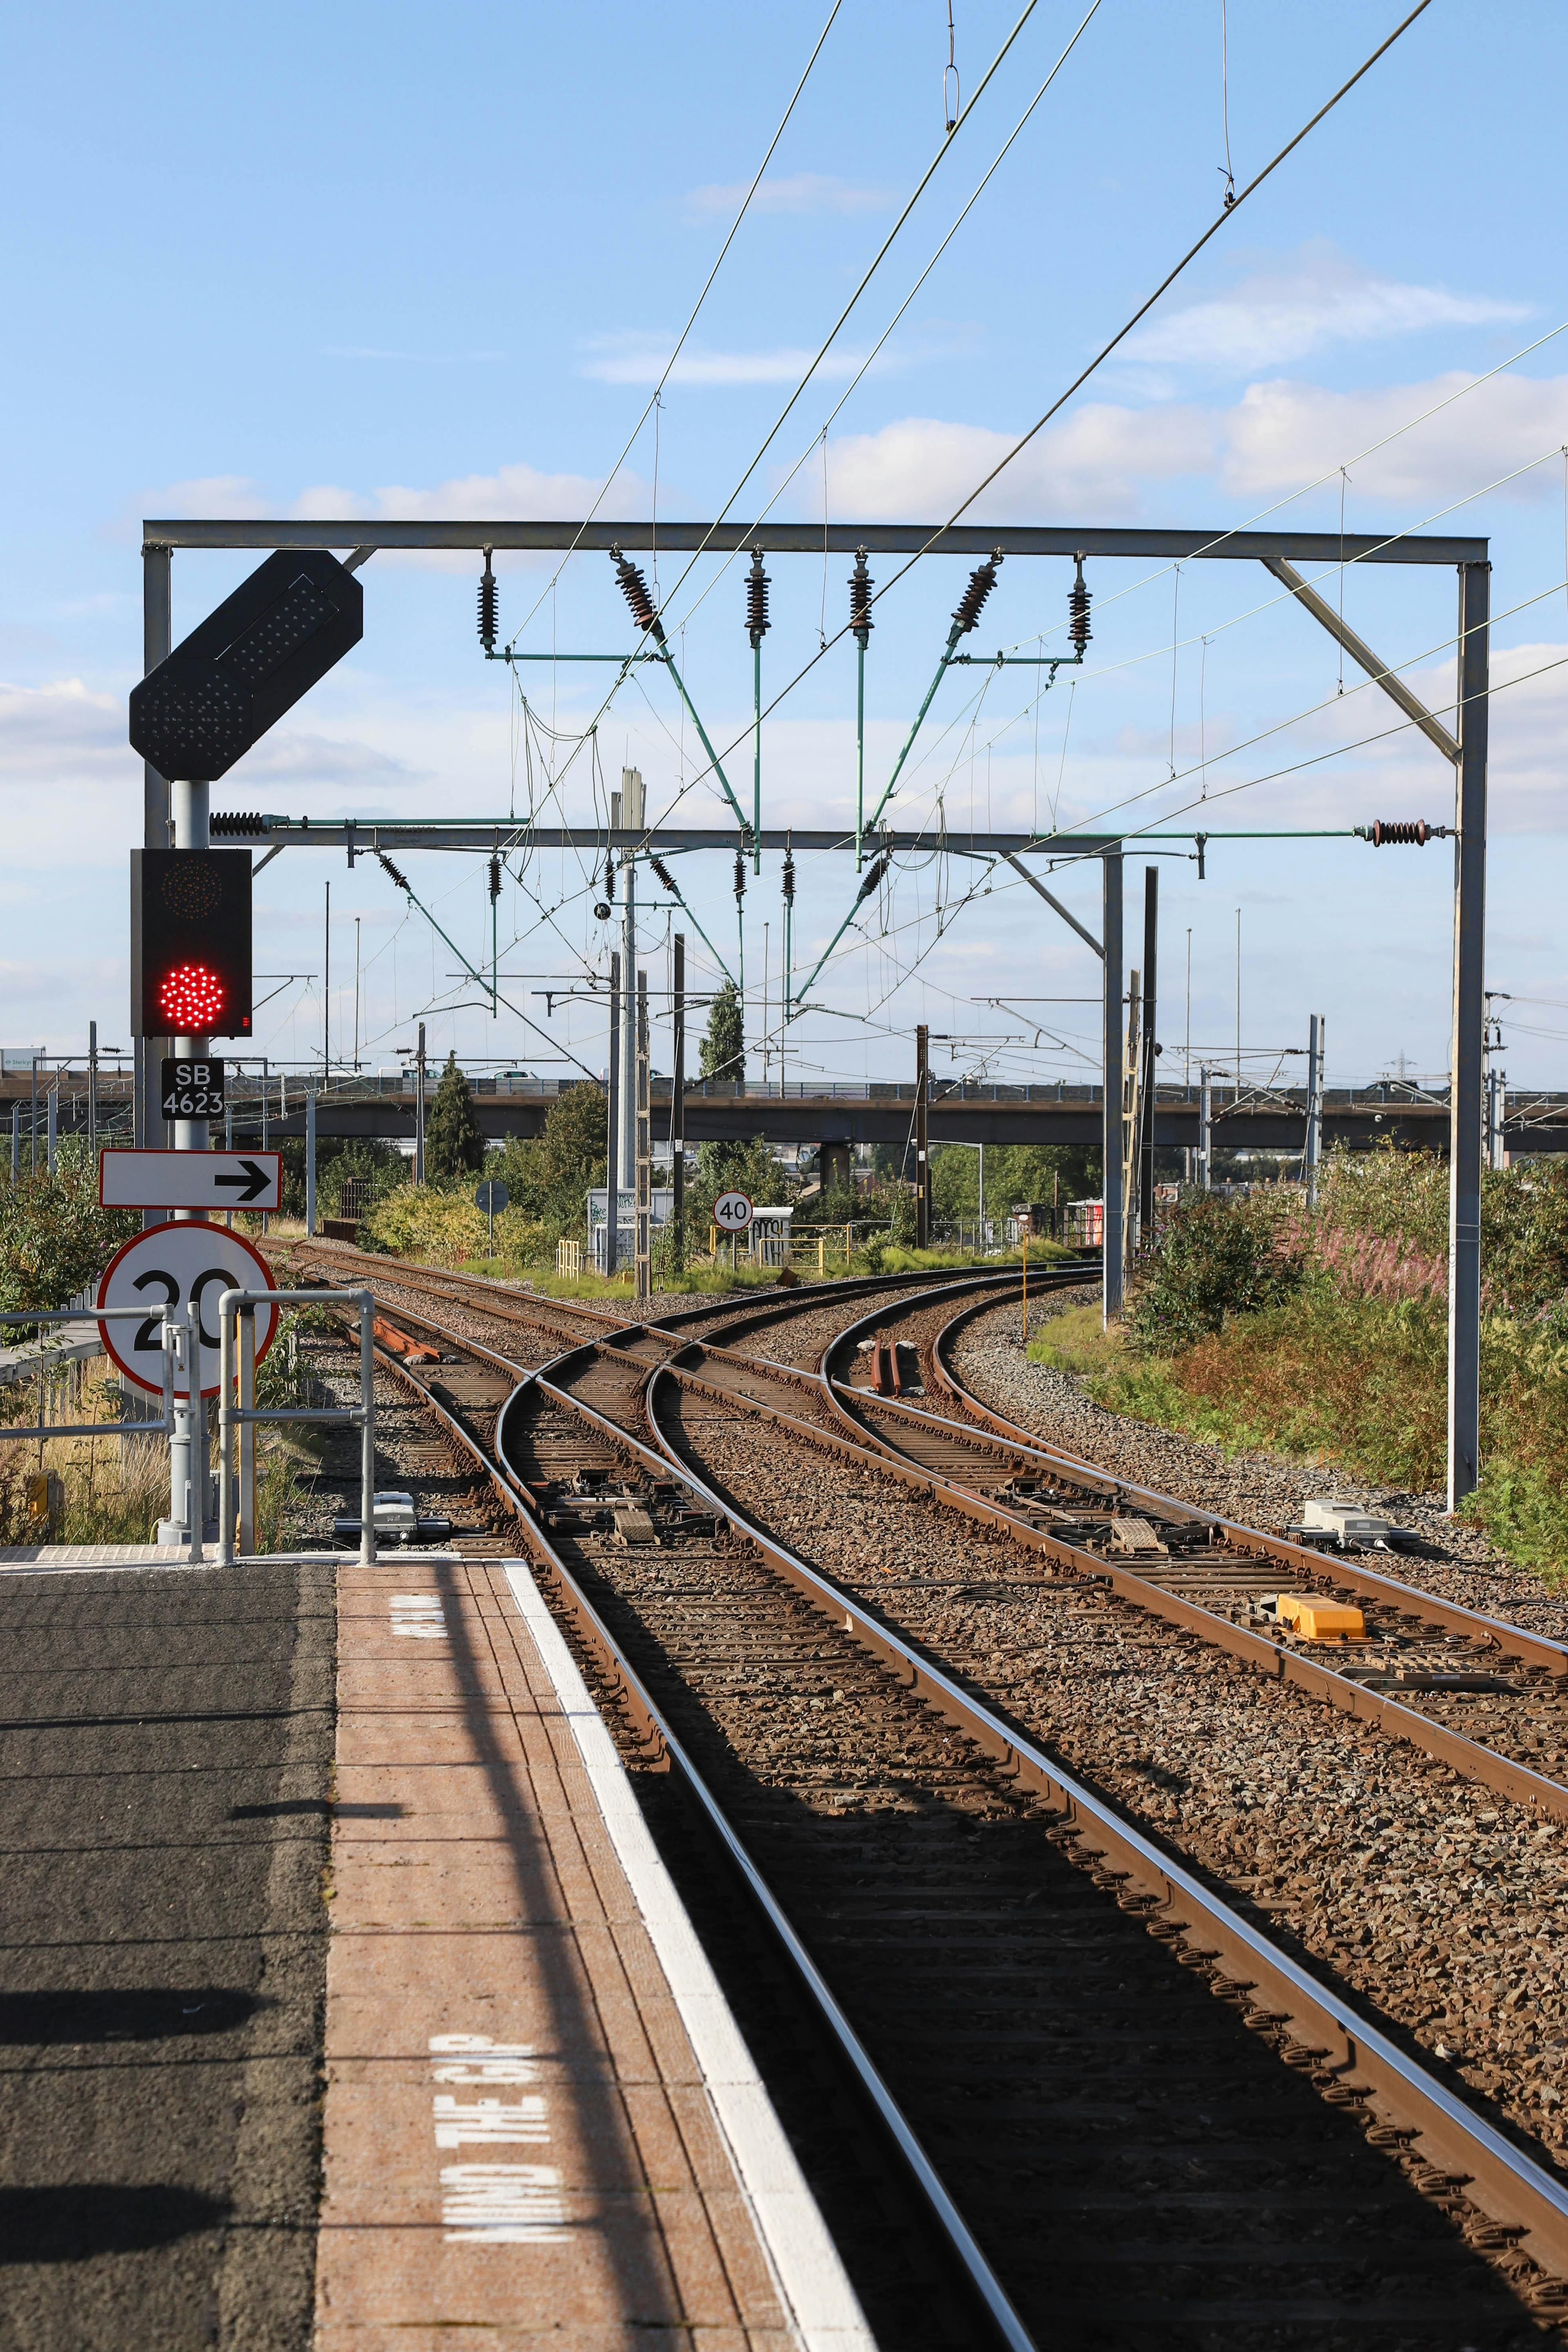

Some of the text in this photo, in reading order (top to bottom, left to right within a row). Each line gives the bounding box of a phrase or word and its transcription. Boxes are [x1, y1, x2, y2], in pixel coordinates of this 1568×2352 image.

[176, 1064, 210, 1086] SB
[163, 1092, 223, 1114] 4623
[720, 1201, 747, 1220] 40
[132, 1268, 240, 1351] 20
[390, 1610, 445, 1622] THE
[428, 2034, 576, 2243] MIND THE GAP
